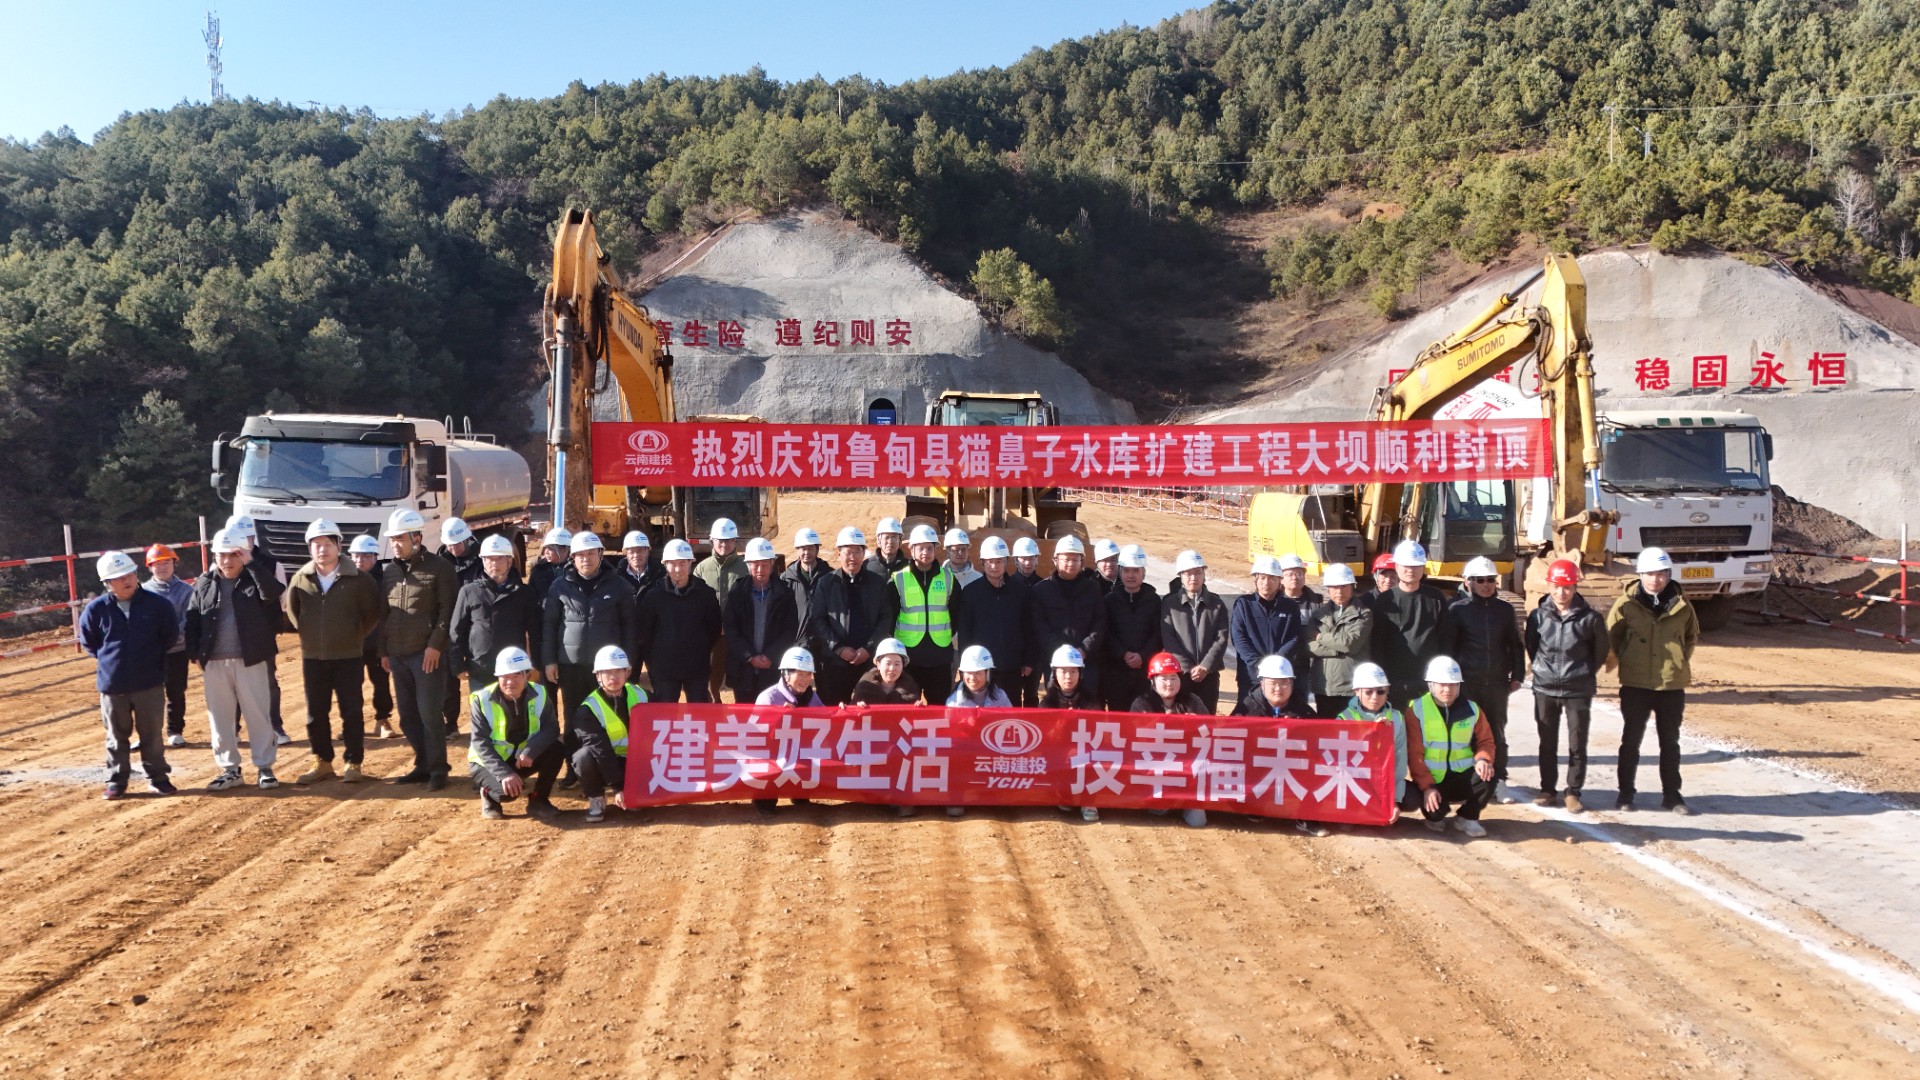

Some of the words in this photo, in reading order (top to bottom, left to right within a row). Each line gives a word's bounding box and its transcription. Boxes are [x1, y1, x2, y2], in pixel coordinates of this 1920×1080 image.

[617, 310, 644, 354] HYUNDAI
[774, 318, 912, 347] 遵纪则安
[1457, 333, 1506, 371] SUMITOMO
[1635, 351, 1848, 392] 稳固永恒
[625, 453, 673, 466] 云南建投
[633, 467, 665, 475] YCIH
[691, 425, 1529, 479] 热烈庆祝鲁甸县猫鼻子水库扩建工程大坝顺利封顶
[648, 713, 953, 796] 建美好生活
[973, 755, 1048, 775] 云南建投
[1069, 718, 1372, 810] 投幸福未来
[986, 776, 1035, 790] YCIH
